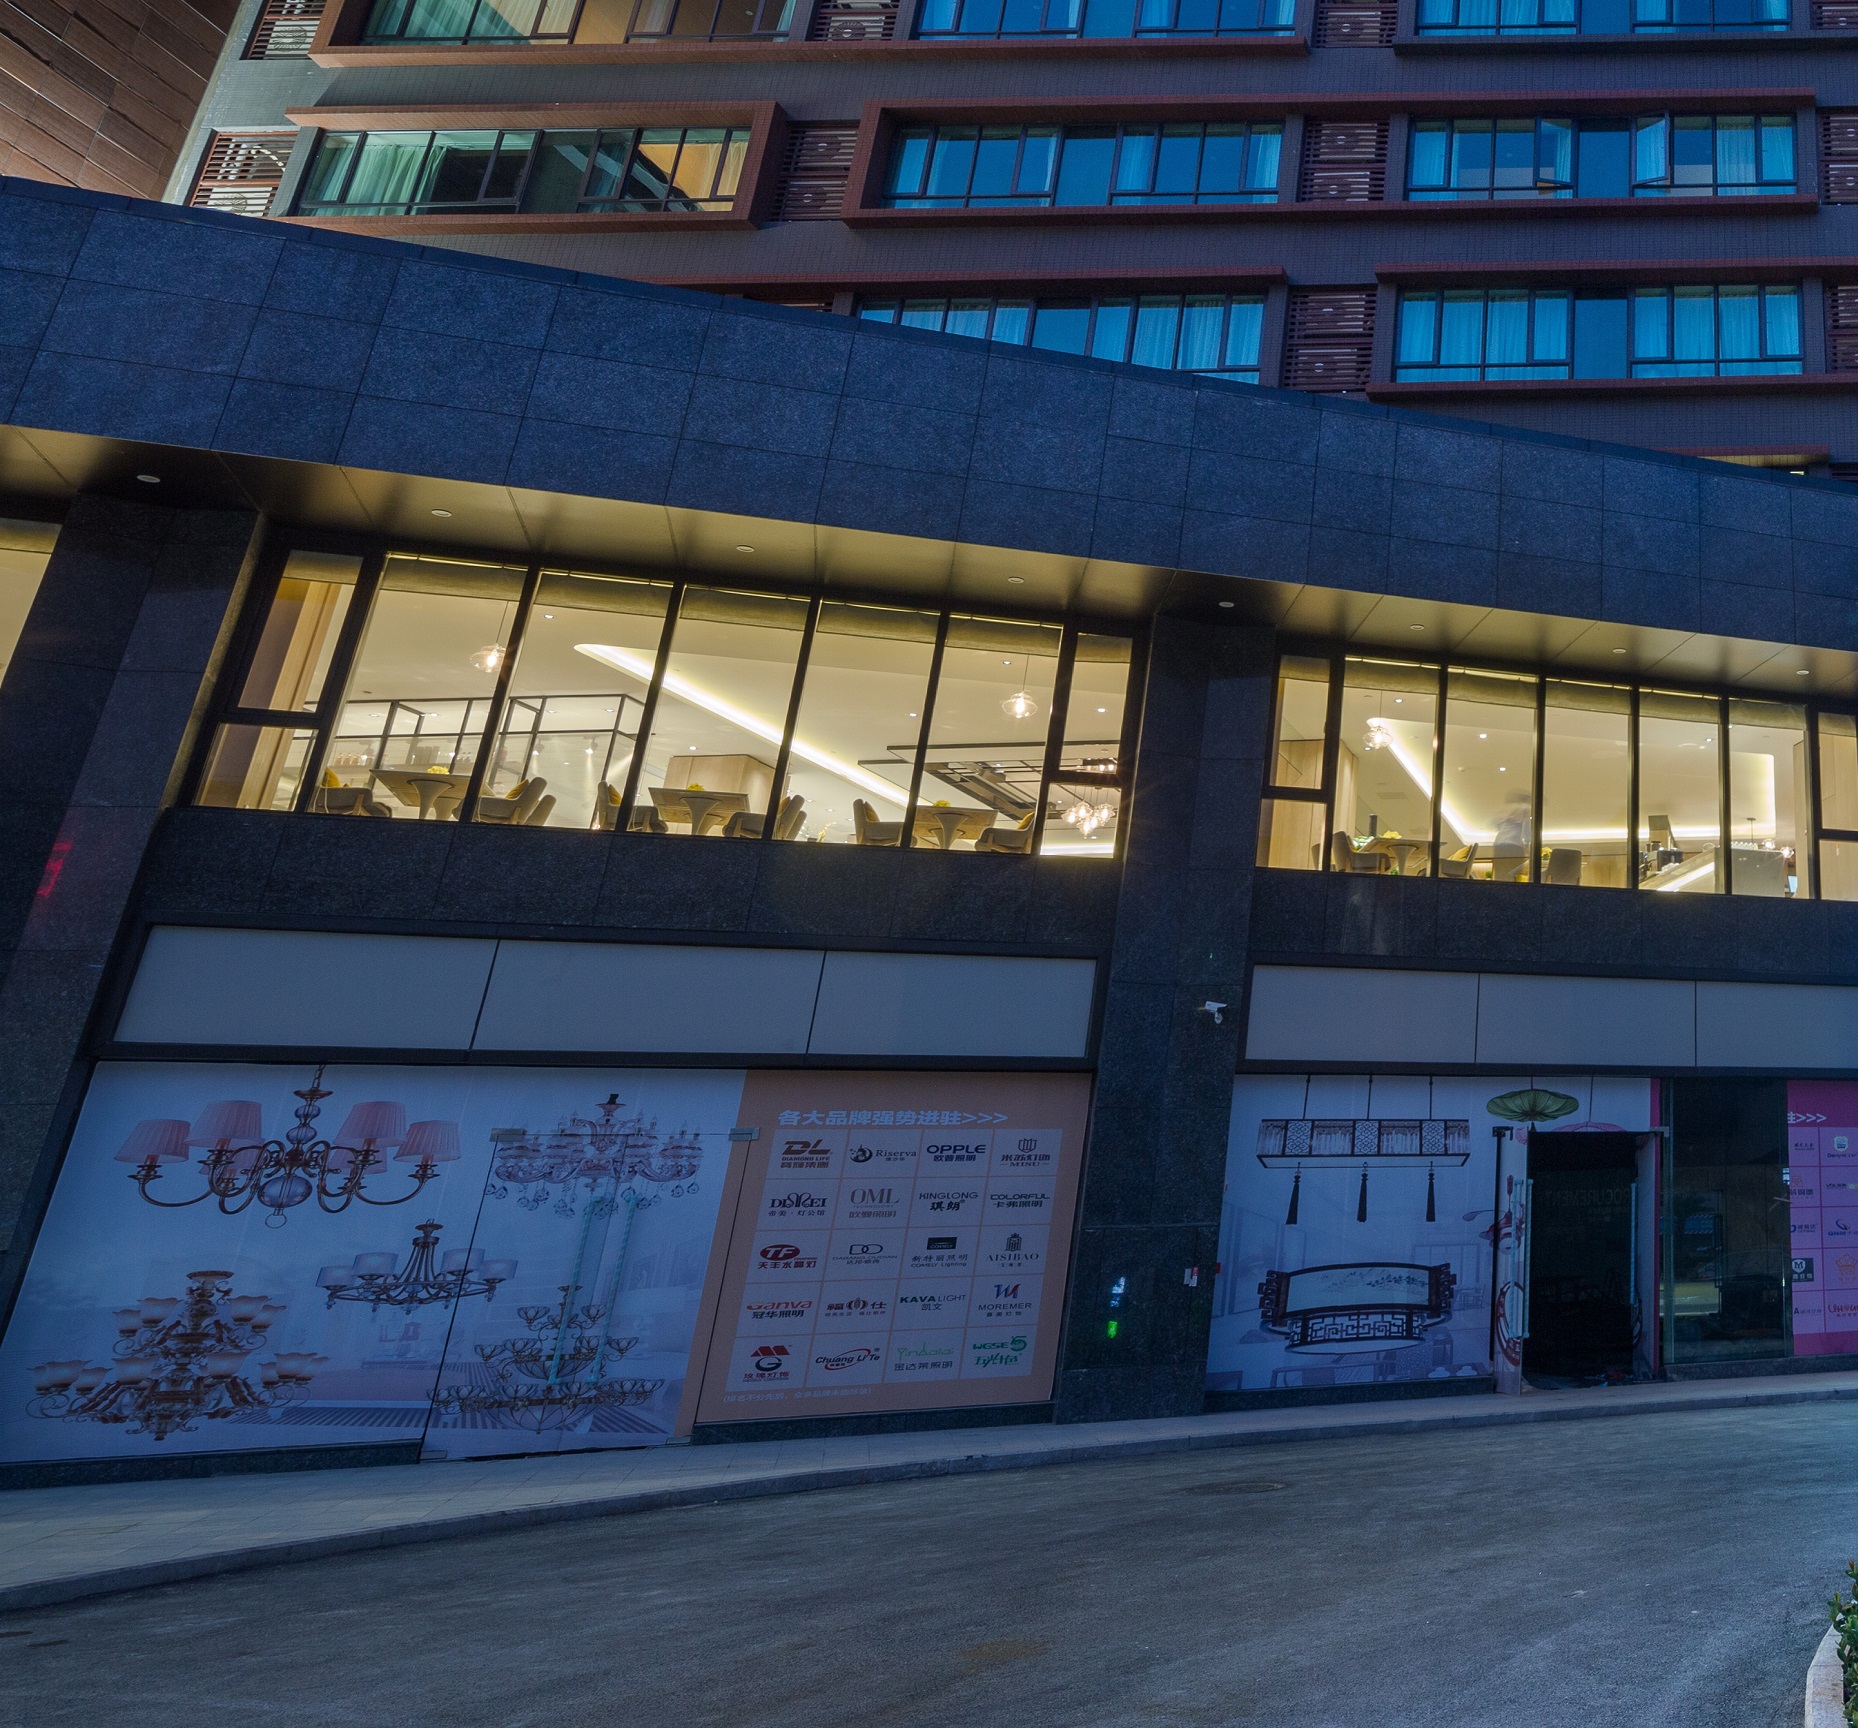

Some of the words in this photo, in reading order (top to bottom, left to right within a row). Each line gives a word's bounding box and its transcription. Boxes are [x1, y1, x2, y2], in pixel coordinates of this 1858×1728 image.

[876, 1149, 917, 1158] Riserva
[926, 1144, 987, 1154] OPPLE
[932, 1154, 977, 1162] 欧普照明
[918, 1191, 979, 1200] KINGLONG
[990, 1193, 1051, 1201] COLORFUL
[900, 1295, 936, 1304] KAVA
[937, 1294, 967, 1302] LIGHT
[977, 1302, 1033, 1311] MOREMER
